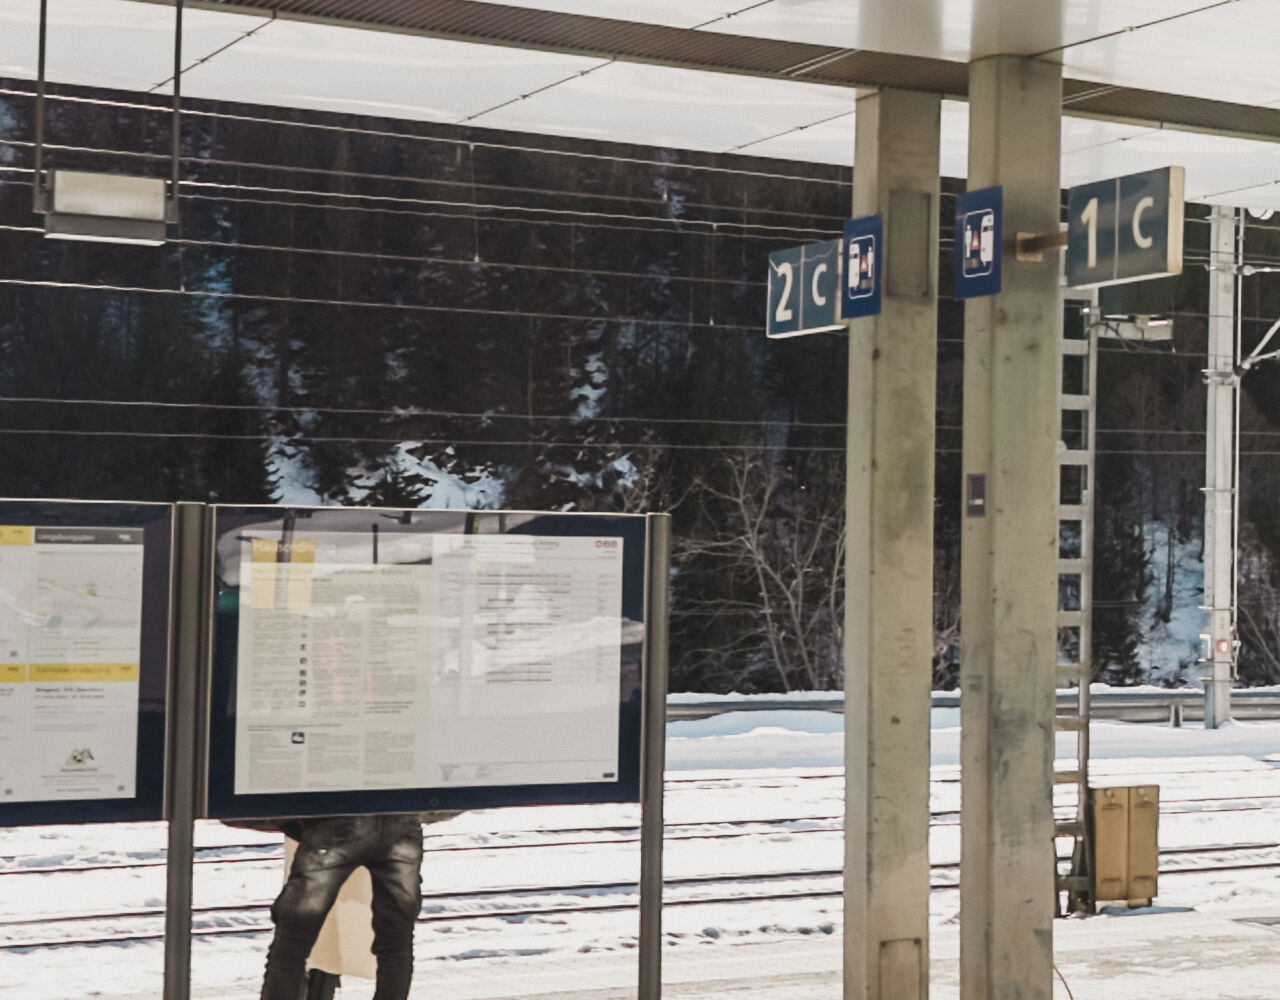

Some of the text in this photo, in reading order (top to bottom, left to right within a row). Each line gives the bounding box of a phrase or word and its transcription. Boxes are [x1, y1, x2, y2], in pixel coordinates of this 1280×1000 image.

[1080, 196, 1154, 269] 1 C
[775, 262, 827, 323] 2 C
